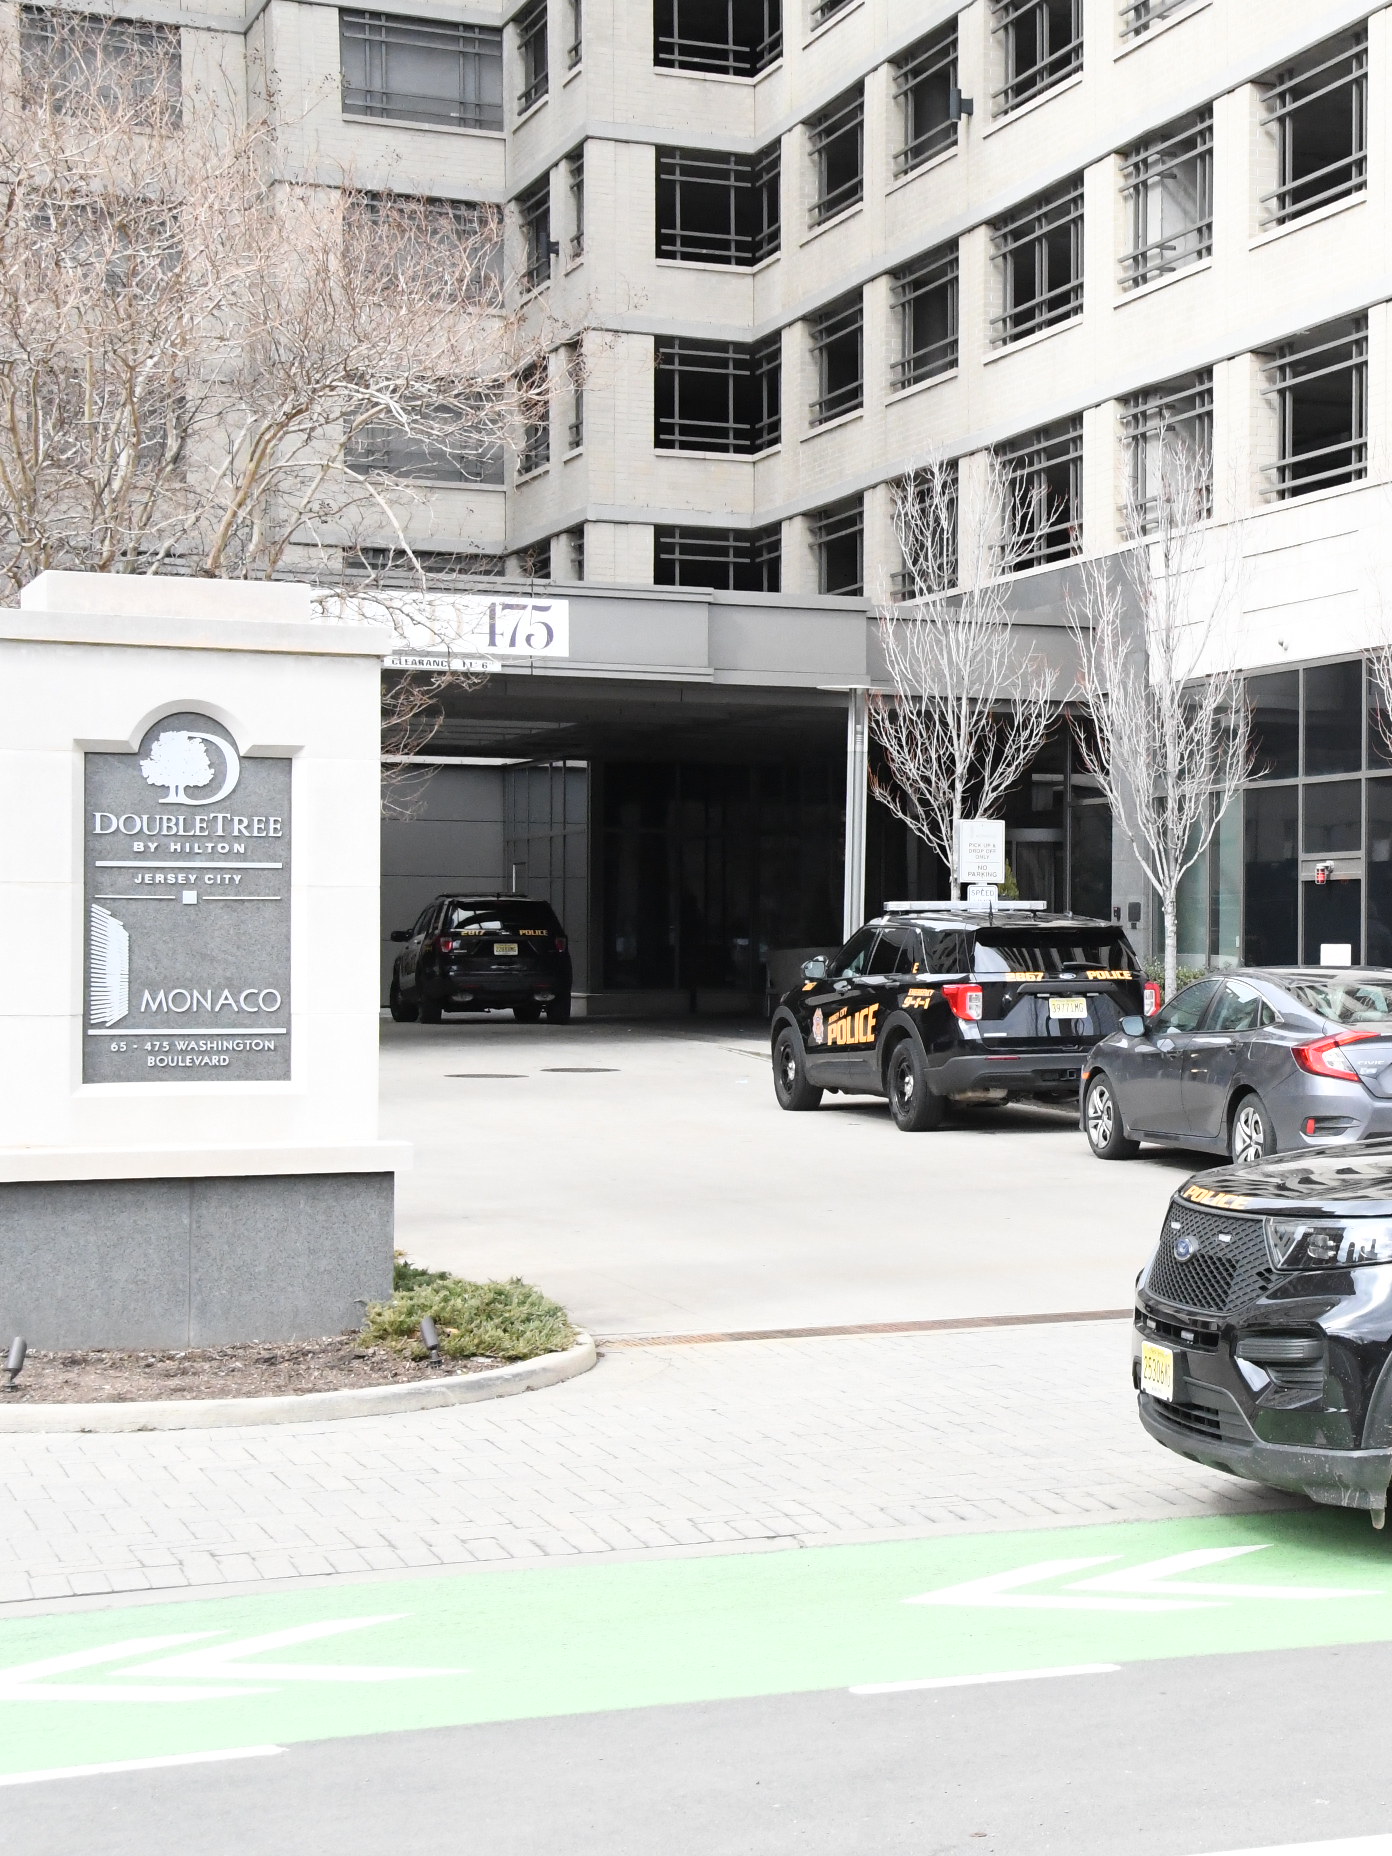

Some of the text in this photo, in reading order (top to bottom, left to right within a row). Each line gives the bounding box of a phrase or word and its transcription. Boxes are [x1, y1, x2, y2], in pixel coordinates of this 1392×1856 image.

[473, 602, 554, 650] 475
[391, 658, 453, 669] CLEARANC
[133, 841, 245, 854] BY HILTON
[134, 873, 243, 885] JERSEY CITY
[971, 889, 995, 897] SPEED
[518, 929, 549, 937] POLICE
[912, 962, 920, 974] E
[1086, 970, 1133, 980] POLICE
[140, 988, 282, 1013] MONACO
[902, 996, 931, 1009] 9-1-1
[827, 1002, 880, 1046] POLICE
[110, 1041, 127, 1052] 65
[144, 1041, 170, 1051] 475
[174, 1039, 275, 1051] WASHINGTON
[147, 1055, 230, 1067] BOULEVARD
[1182, 1184, 1252, 1210] POLICE
